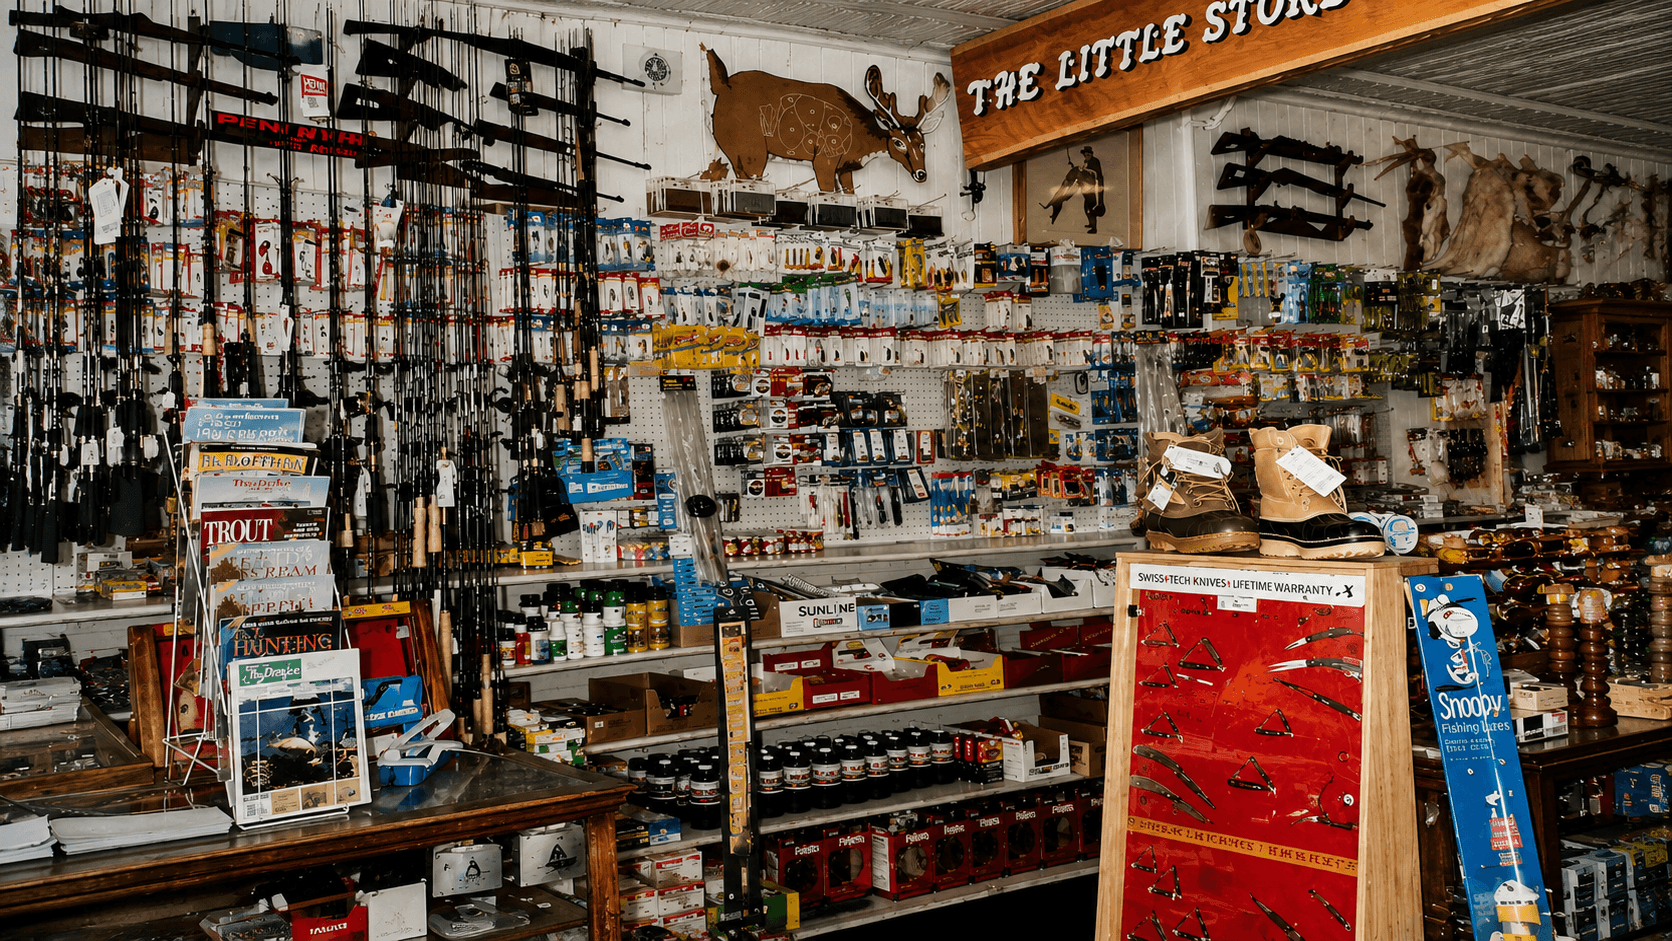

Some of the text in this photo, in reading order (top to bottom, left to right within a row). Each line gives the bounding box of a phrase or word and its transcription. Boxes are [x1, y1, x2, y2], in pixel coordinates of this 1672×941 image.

[967, 0, 1345, 116] THE LITTLE STOR
[204, 519, 272, 545] TROUT
[1193, 576, 1227, 588] KNIVES
[1232, 579, 1273, 592] LIFETIME
[1274, 582, 1333, 596] WARRANTY
[798, 603, 855, 617] SUNLINE
[234, 633, 332, 657] HUNTING
[1438, 692, 1502, 720] Snoopy
[1441, 722, 1480, 735] Fishing
